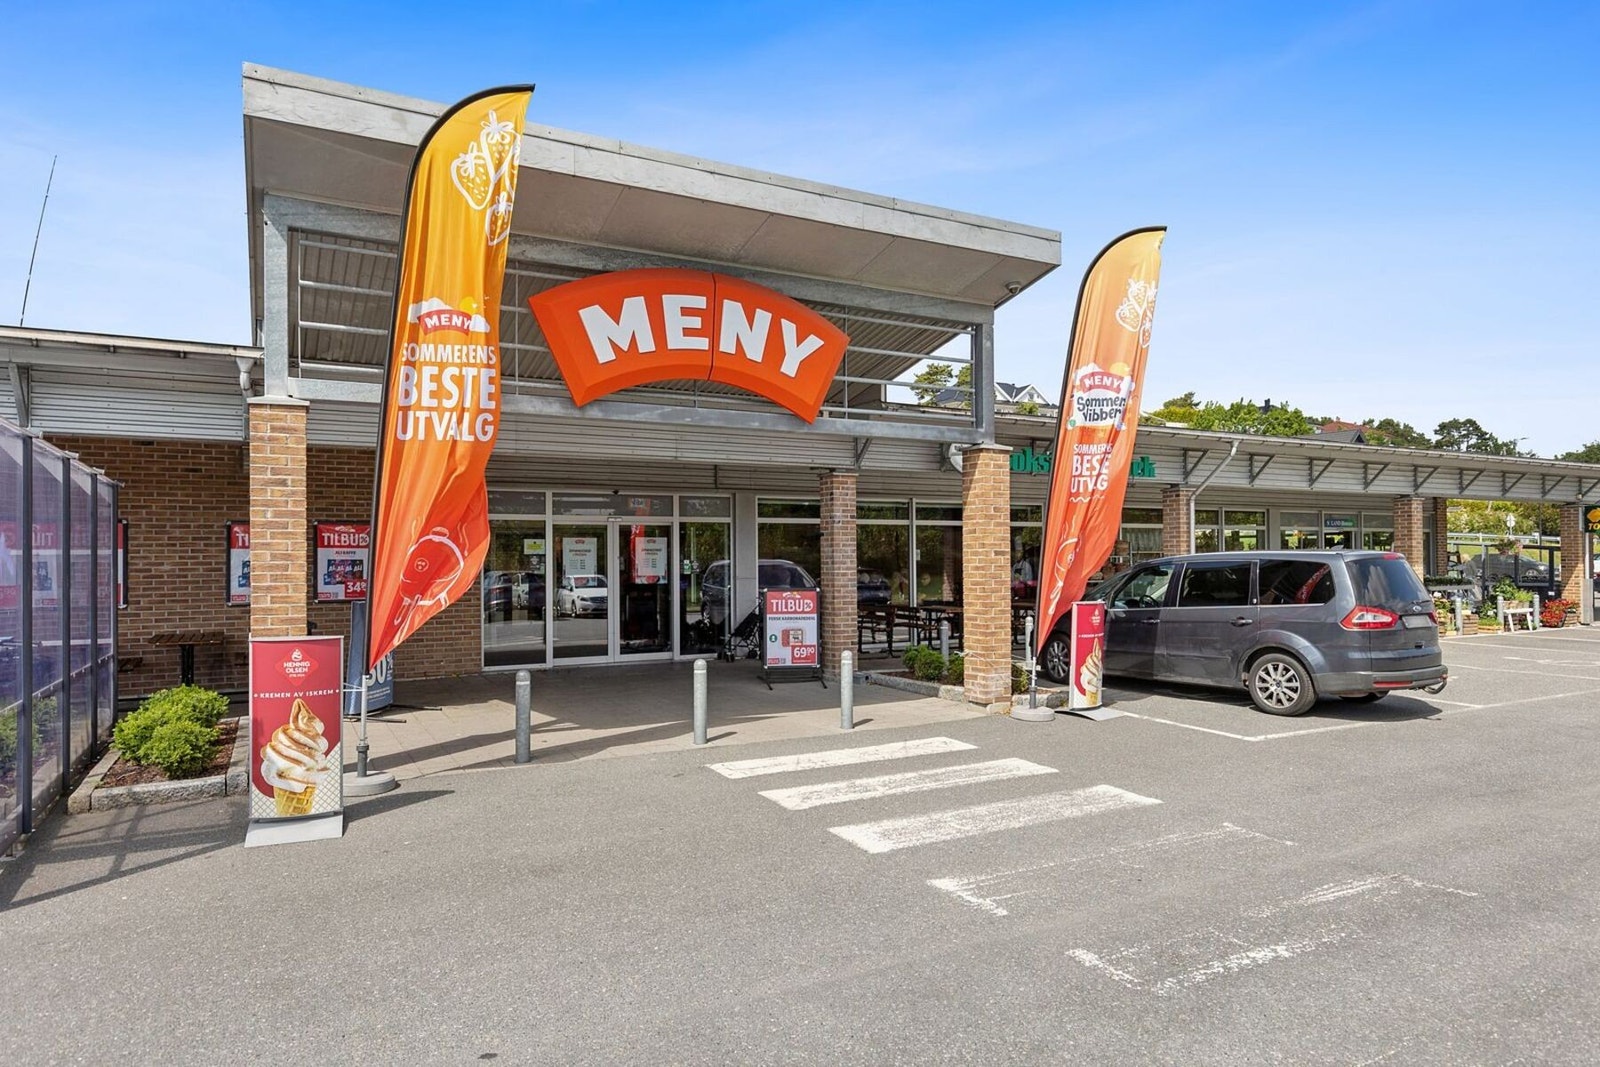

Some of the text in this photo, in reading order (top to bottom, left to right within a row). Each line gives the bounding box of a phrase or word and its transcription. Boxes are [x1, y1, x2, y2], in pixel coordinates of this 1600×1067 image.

[424, 313, 472, 329] MENY
[578, 294, 825, 378] MENY
[398, 365, 496, 409] BESTE
[1083, 375, 1121, 389] MENY
[396, 411, 495, 442] UTVALG
[1072, 454, 1111, 476] BESE
[1588, 522, 1600, 530] TO
[322, 533, 369, 546] TILBUD
[771, 599, 814, 612] TILBUD
[306, 689, 334, 697] ISKREM
